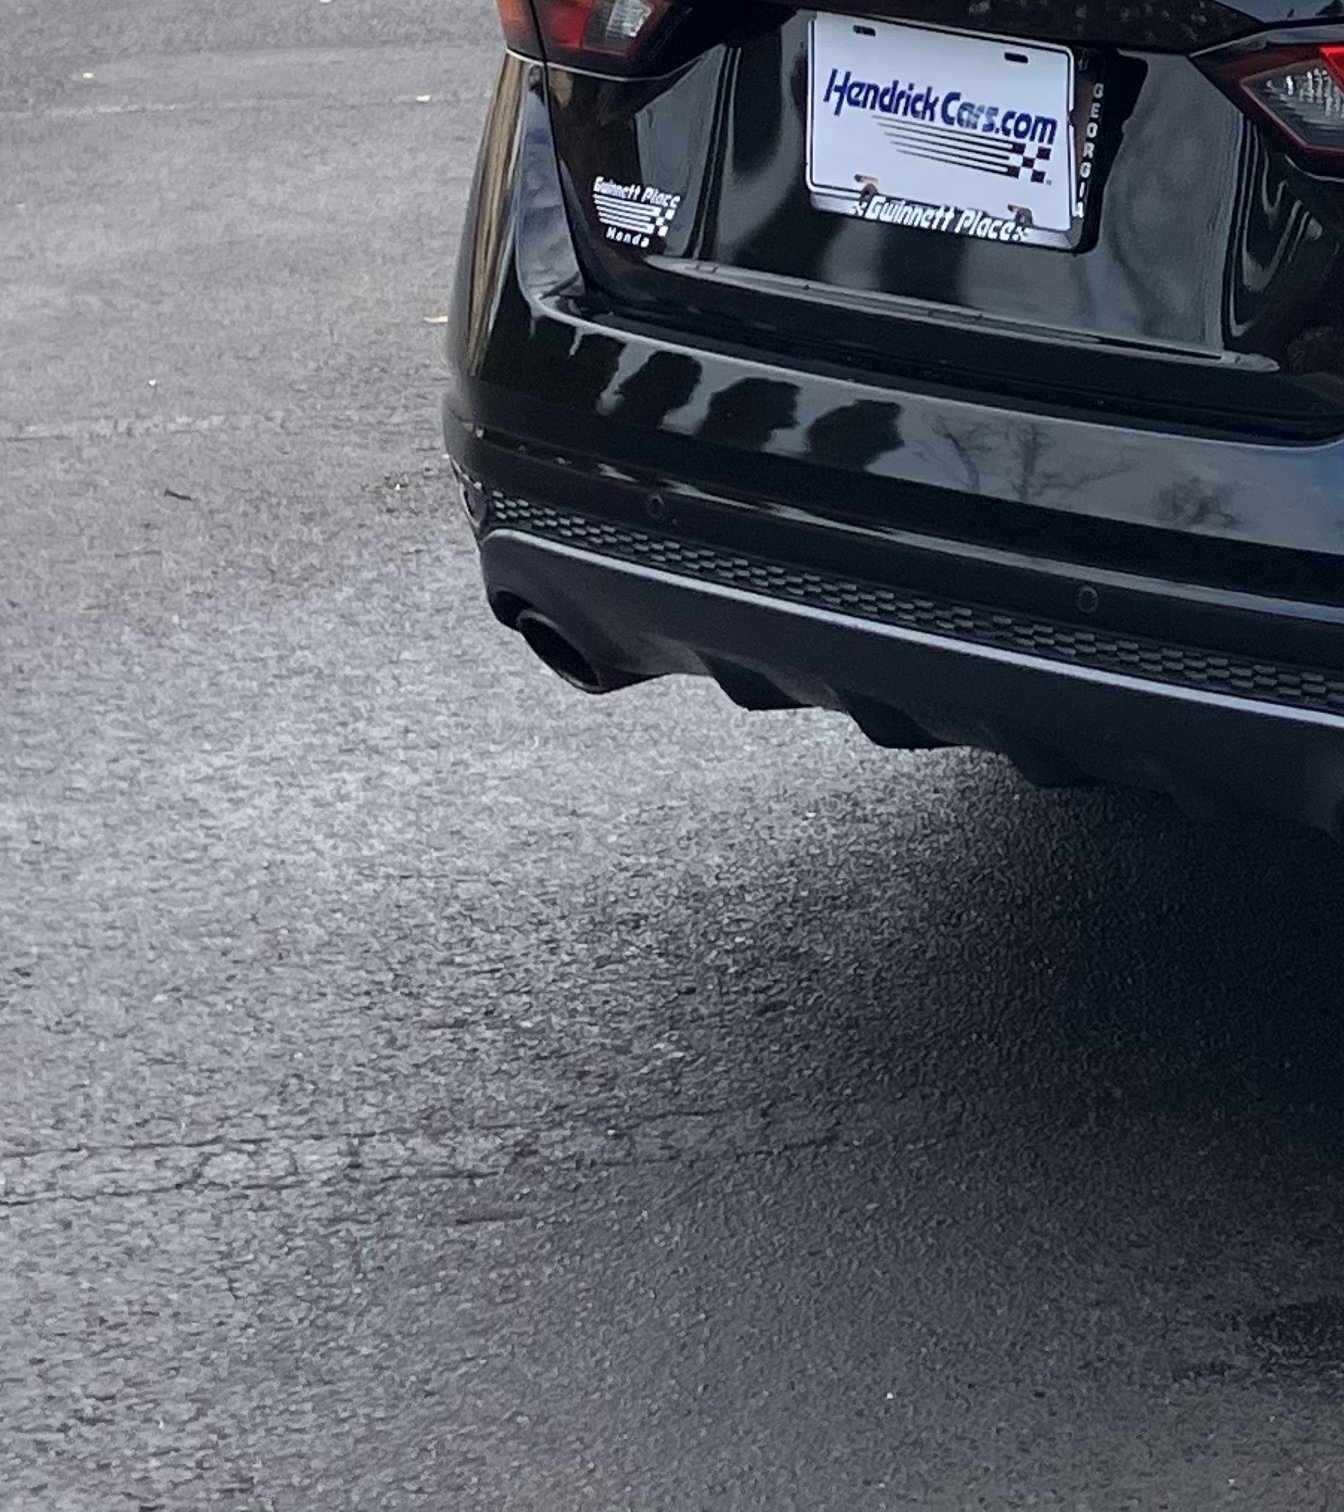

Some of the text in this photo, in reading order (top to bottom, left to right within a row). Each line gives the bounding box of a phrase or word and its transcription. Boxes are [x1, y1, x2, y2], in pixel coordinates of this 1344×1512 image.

[1073, 83, 1104, 218] GEORGIA
[865, 196, 1016, 239] Gwinnett Place
